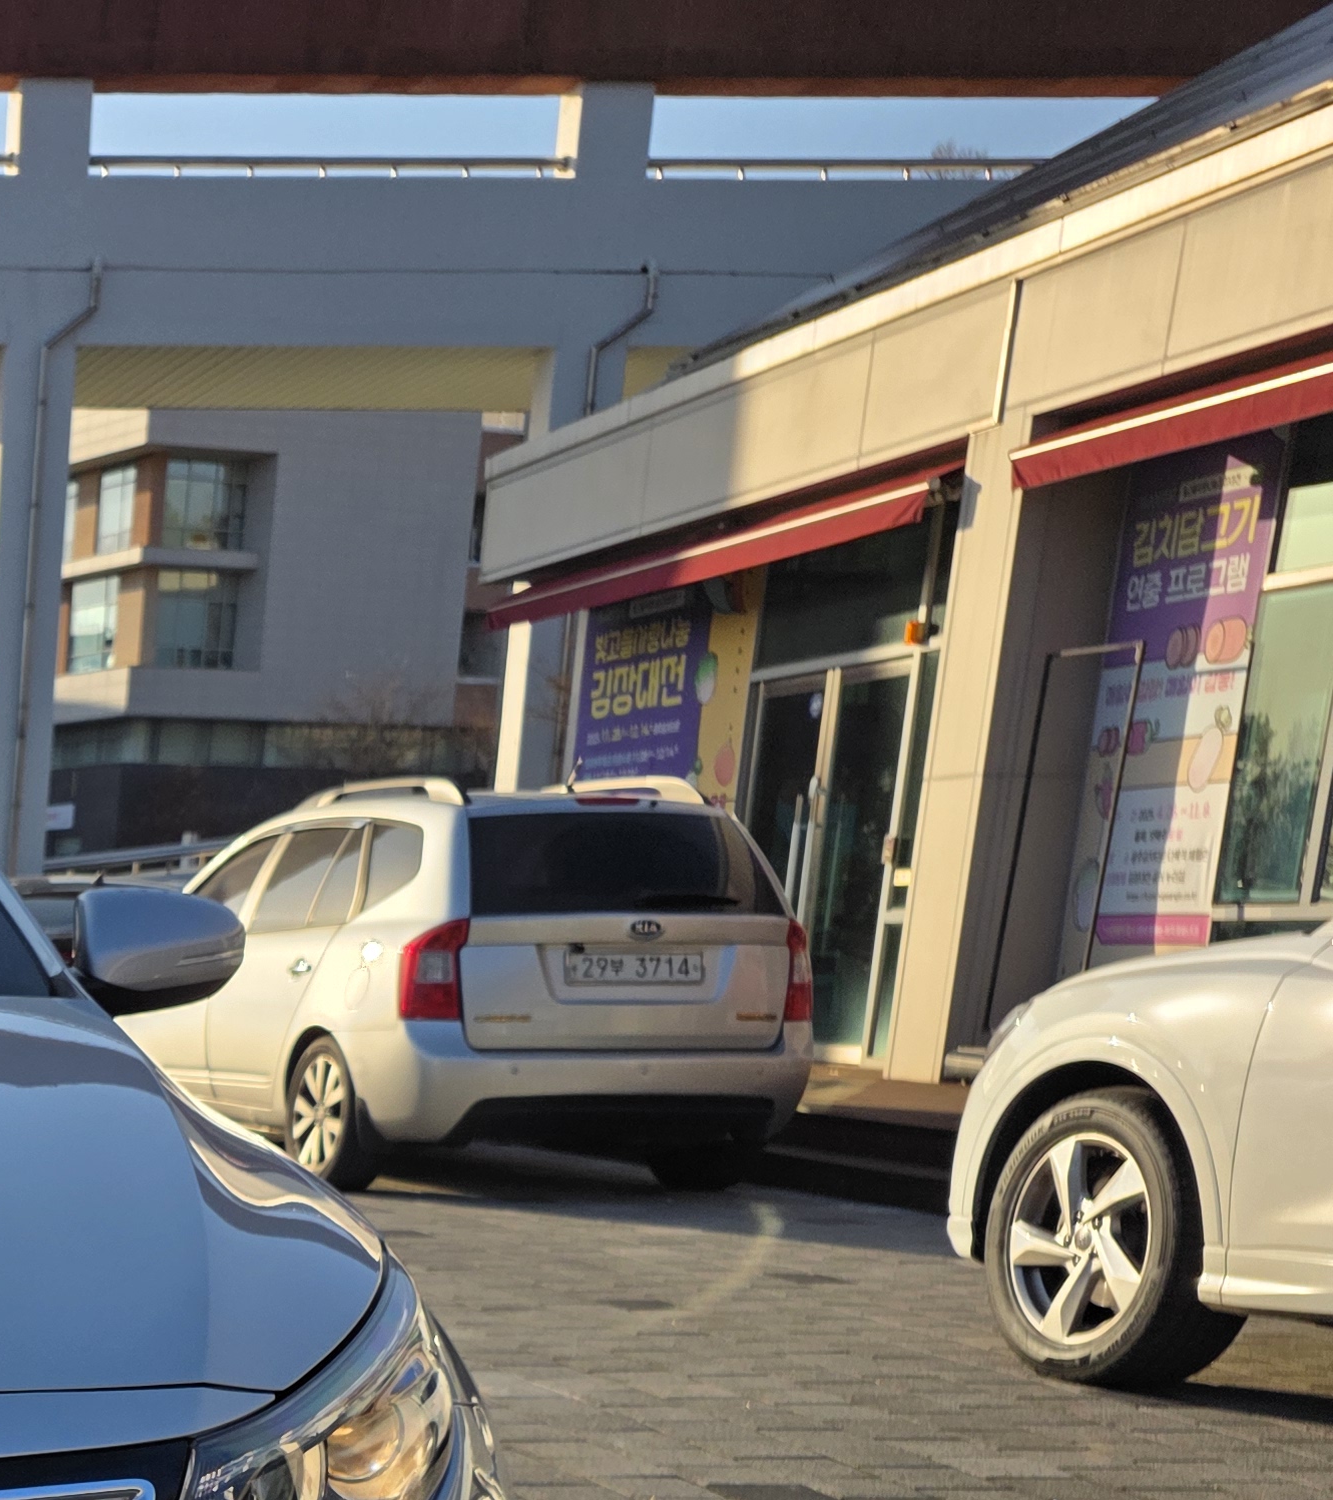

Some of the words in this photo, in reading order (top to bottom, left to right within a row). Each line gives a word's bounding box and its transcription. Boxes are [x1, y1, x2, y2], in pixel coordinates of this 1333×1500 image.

[1165, 551, 1251, 604] 프로그램
[590, 653, 688, 720] 김장대전
[635, 919, 660, 933] KIA
[582, 956, 624, 979] 29부
[635, 954, 691, 978] 3714
